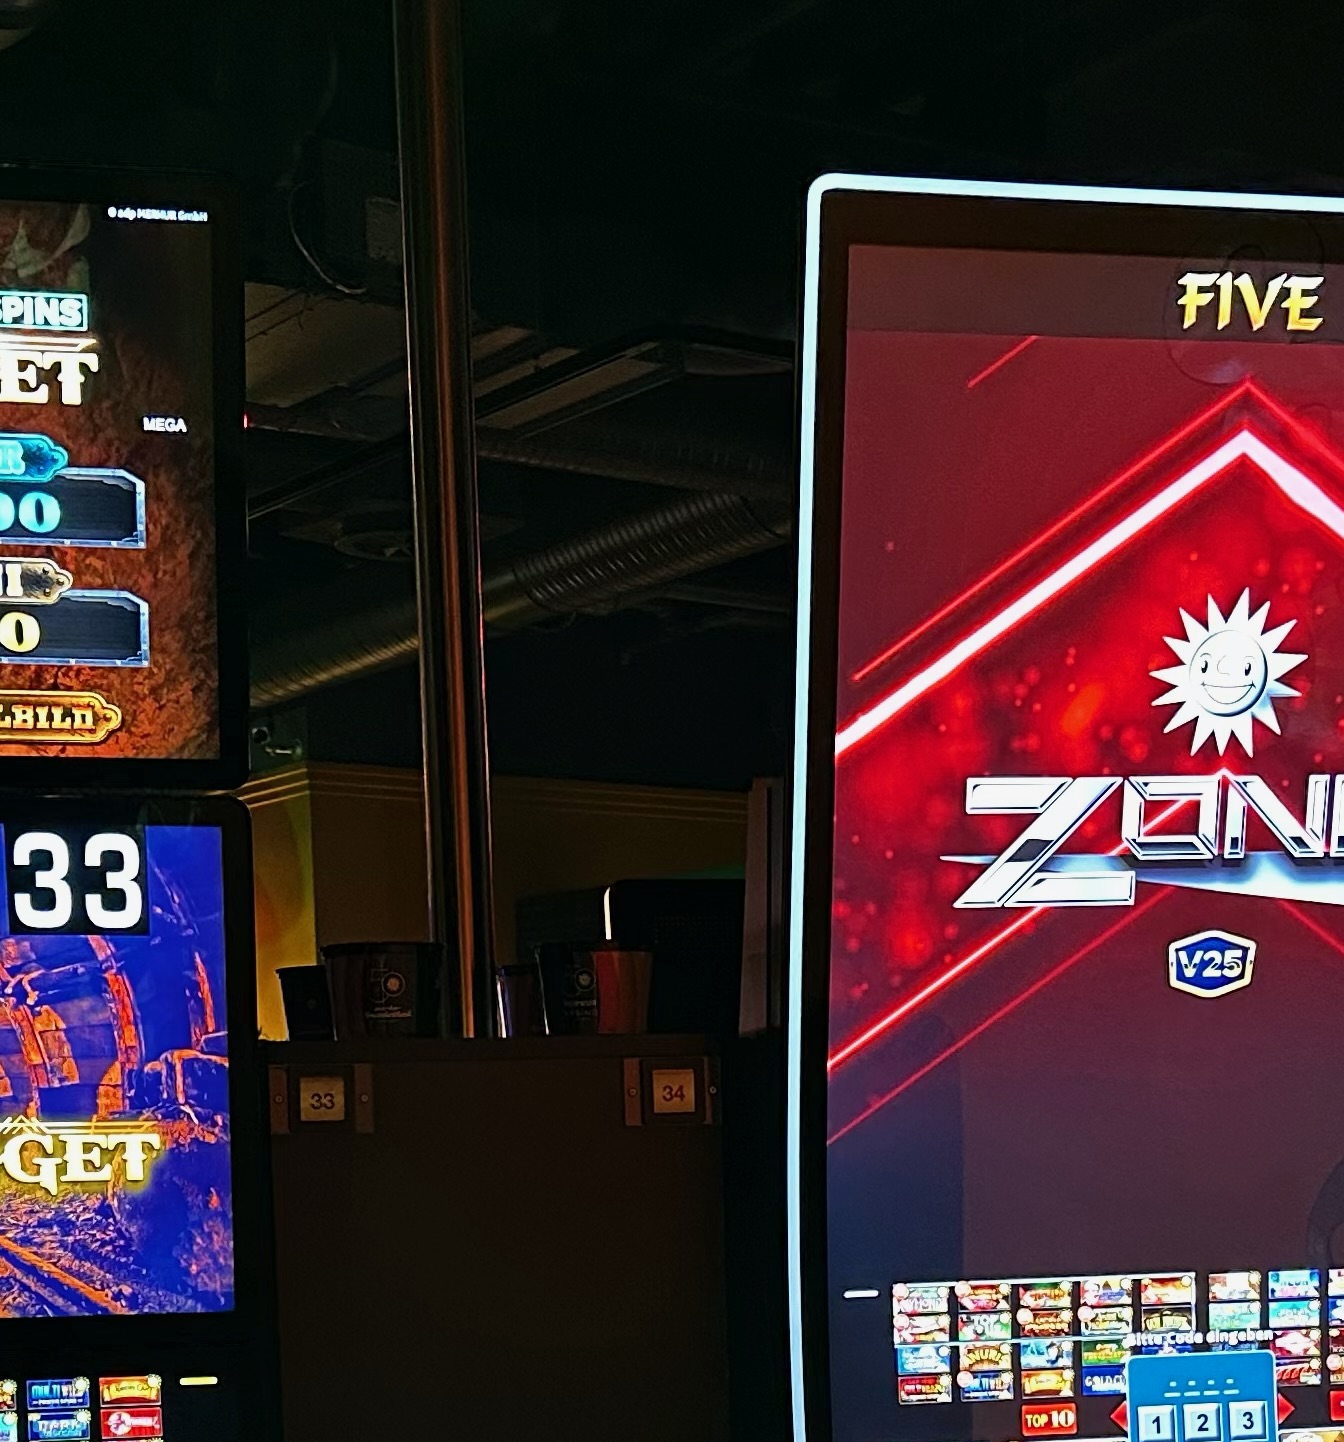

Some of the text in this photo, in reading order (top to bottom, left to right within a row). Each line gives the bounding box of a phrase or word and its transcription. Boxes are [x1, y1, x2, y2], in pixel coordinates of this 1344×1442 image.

[178, 210, 208, 222] GmbH
[1176, 271, 1325, 332] FIVE
[144, 416, 187, 433] MEGA
[12, 831, 143, 931] 33
[1178, 949, 1243, 978] V25
[310, 1092, 336, 1111] 33
[662, 1085, 686, 1102] 34
[1025, 1410, 1076, 1428] TOP 10
[1152, 1416, 1162, 1434] 1
[1197, 1414, 1209, 1432] 2
[1242, 1411, 1254, 1429] 3
